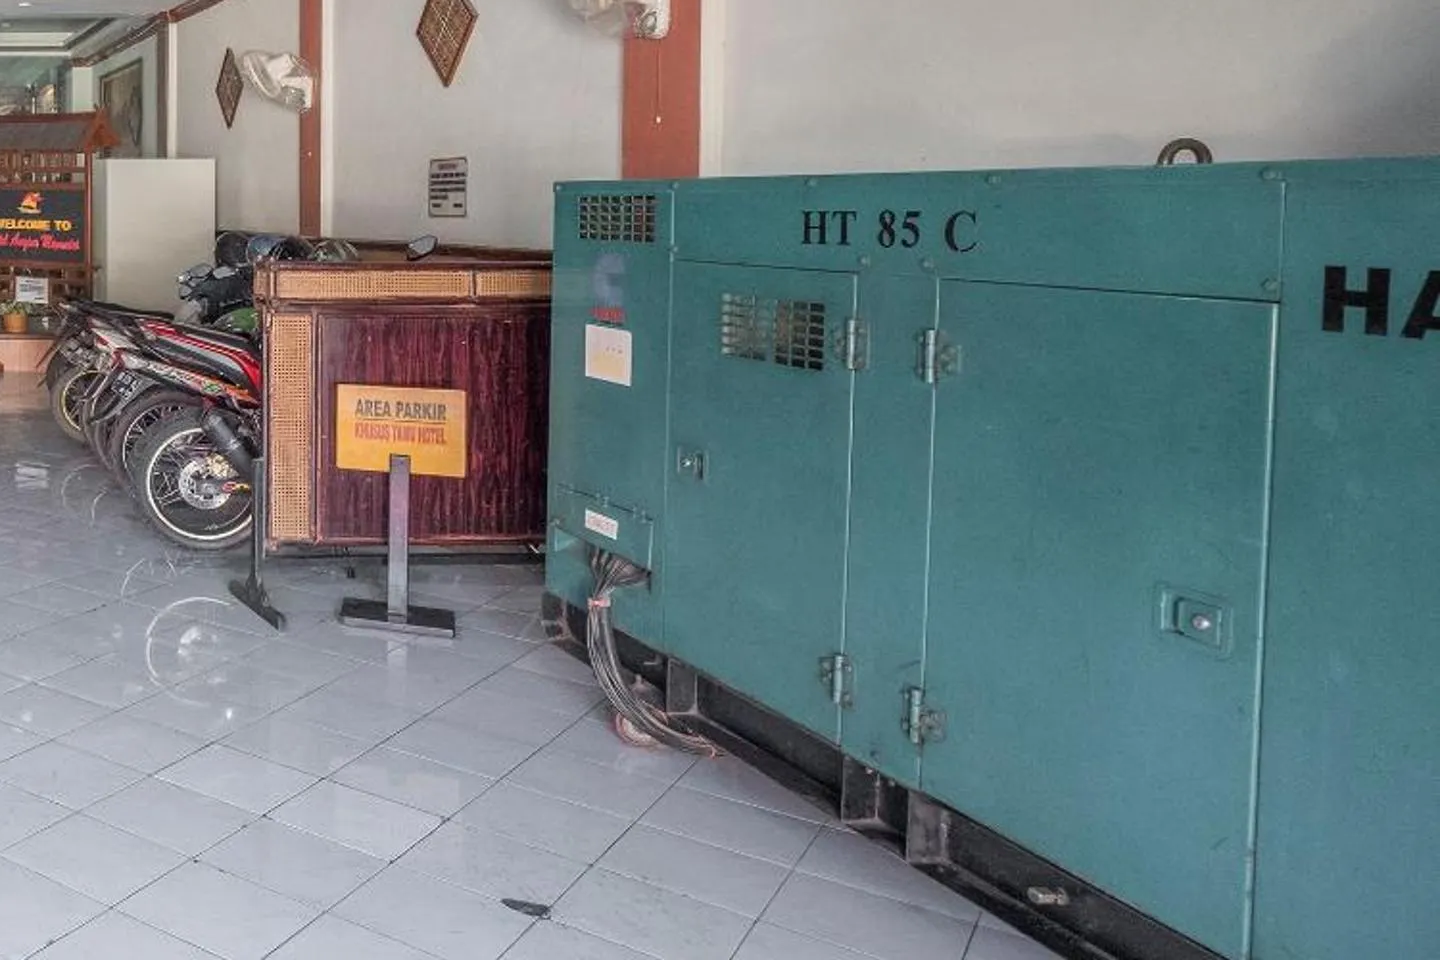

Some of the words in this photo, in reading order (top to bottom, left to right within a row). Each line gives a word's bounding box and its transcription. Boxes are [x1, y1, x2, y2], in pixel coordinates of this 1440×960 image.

[52, 220, 72, 233] TO
[801, 209, 857, 246] HT
[877, 208, 923, 249] 85
[944, 209, 979, 253] C
[354, 398, 392, 418] AREA
[394, 401, 448, 422] PARKIR
